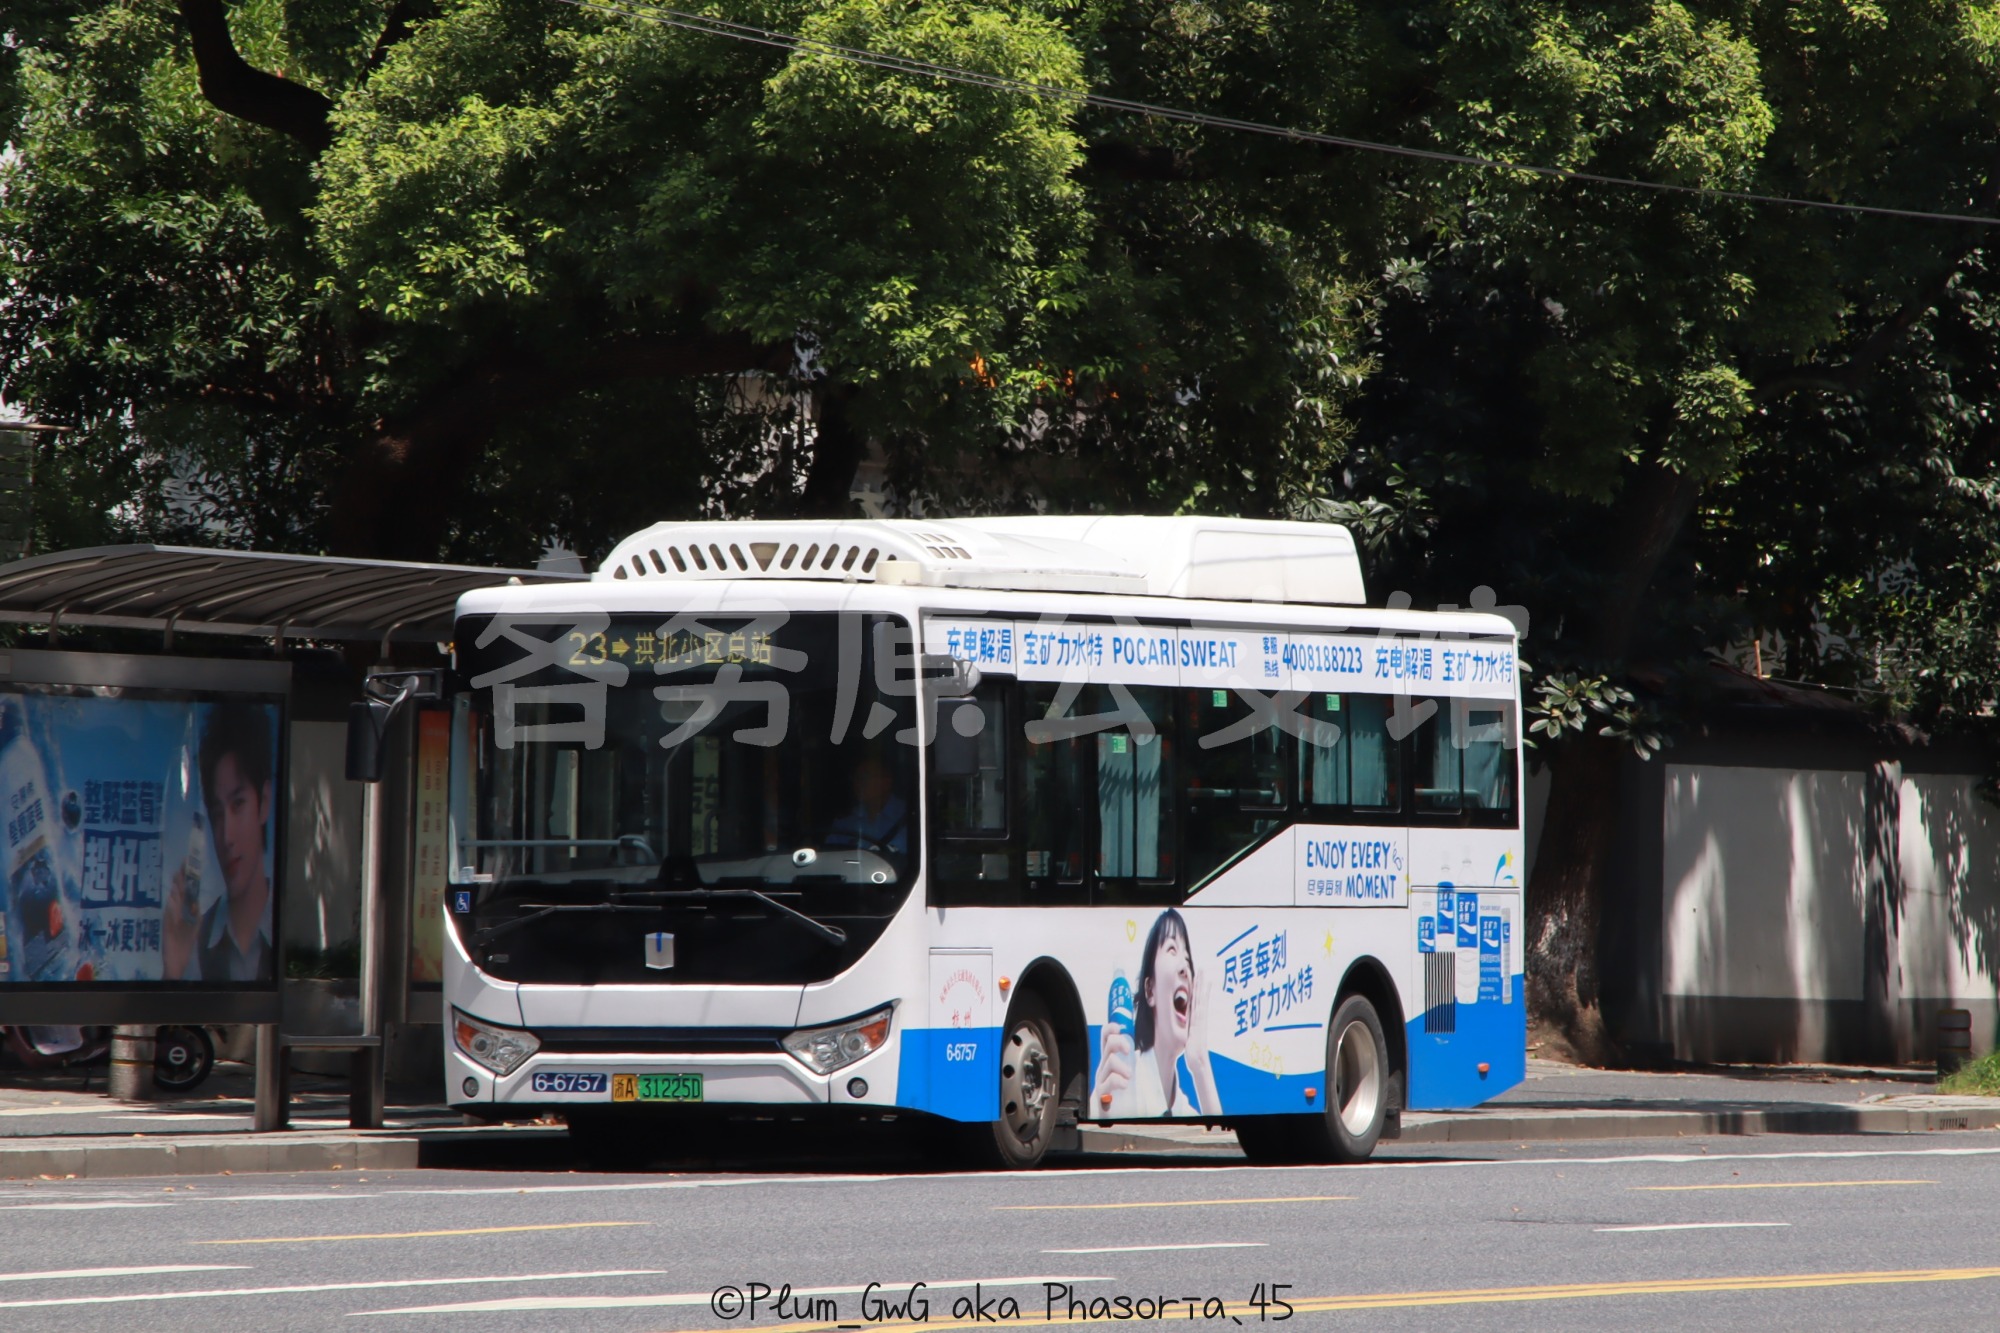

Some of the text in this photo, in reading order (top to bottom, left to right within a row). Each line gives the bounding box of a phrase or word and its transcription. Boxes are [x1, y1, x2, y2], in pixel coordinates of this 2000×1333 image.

[568, 631, 771, 665] 23 拱北小区总站
[946, 627, 1238, 668] 充电解渴 宝矿力水特 POCARI SWEAT
[1282, 643, 1513, 683] 4008188223 充电解渴 宝矿力水特
[1306, 840, 1391, 870] ENJOY EVERY
[1345, 873, 1397, 899] MOMENT
[78, 917, 160, 952] 冰一冰更好喝
[1222, 929, 1287, 994] 尽享每刻
[1234, 964, 1313, 1037] 宝矿力水特
[946, 1043, 978, 1062] 6-6757
[534, 1073, 603, 1092] 6-6757
